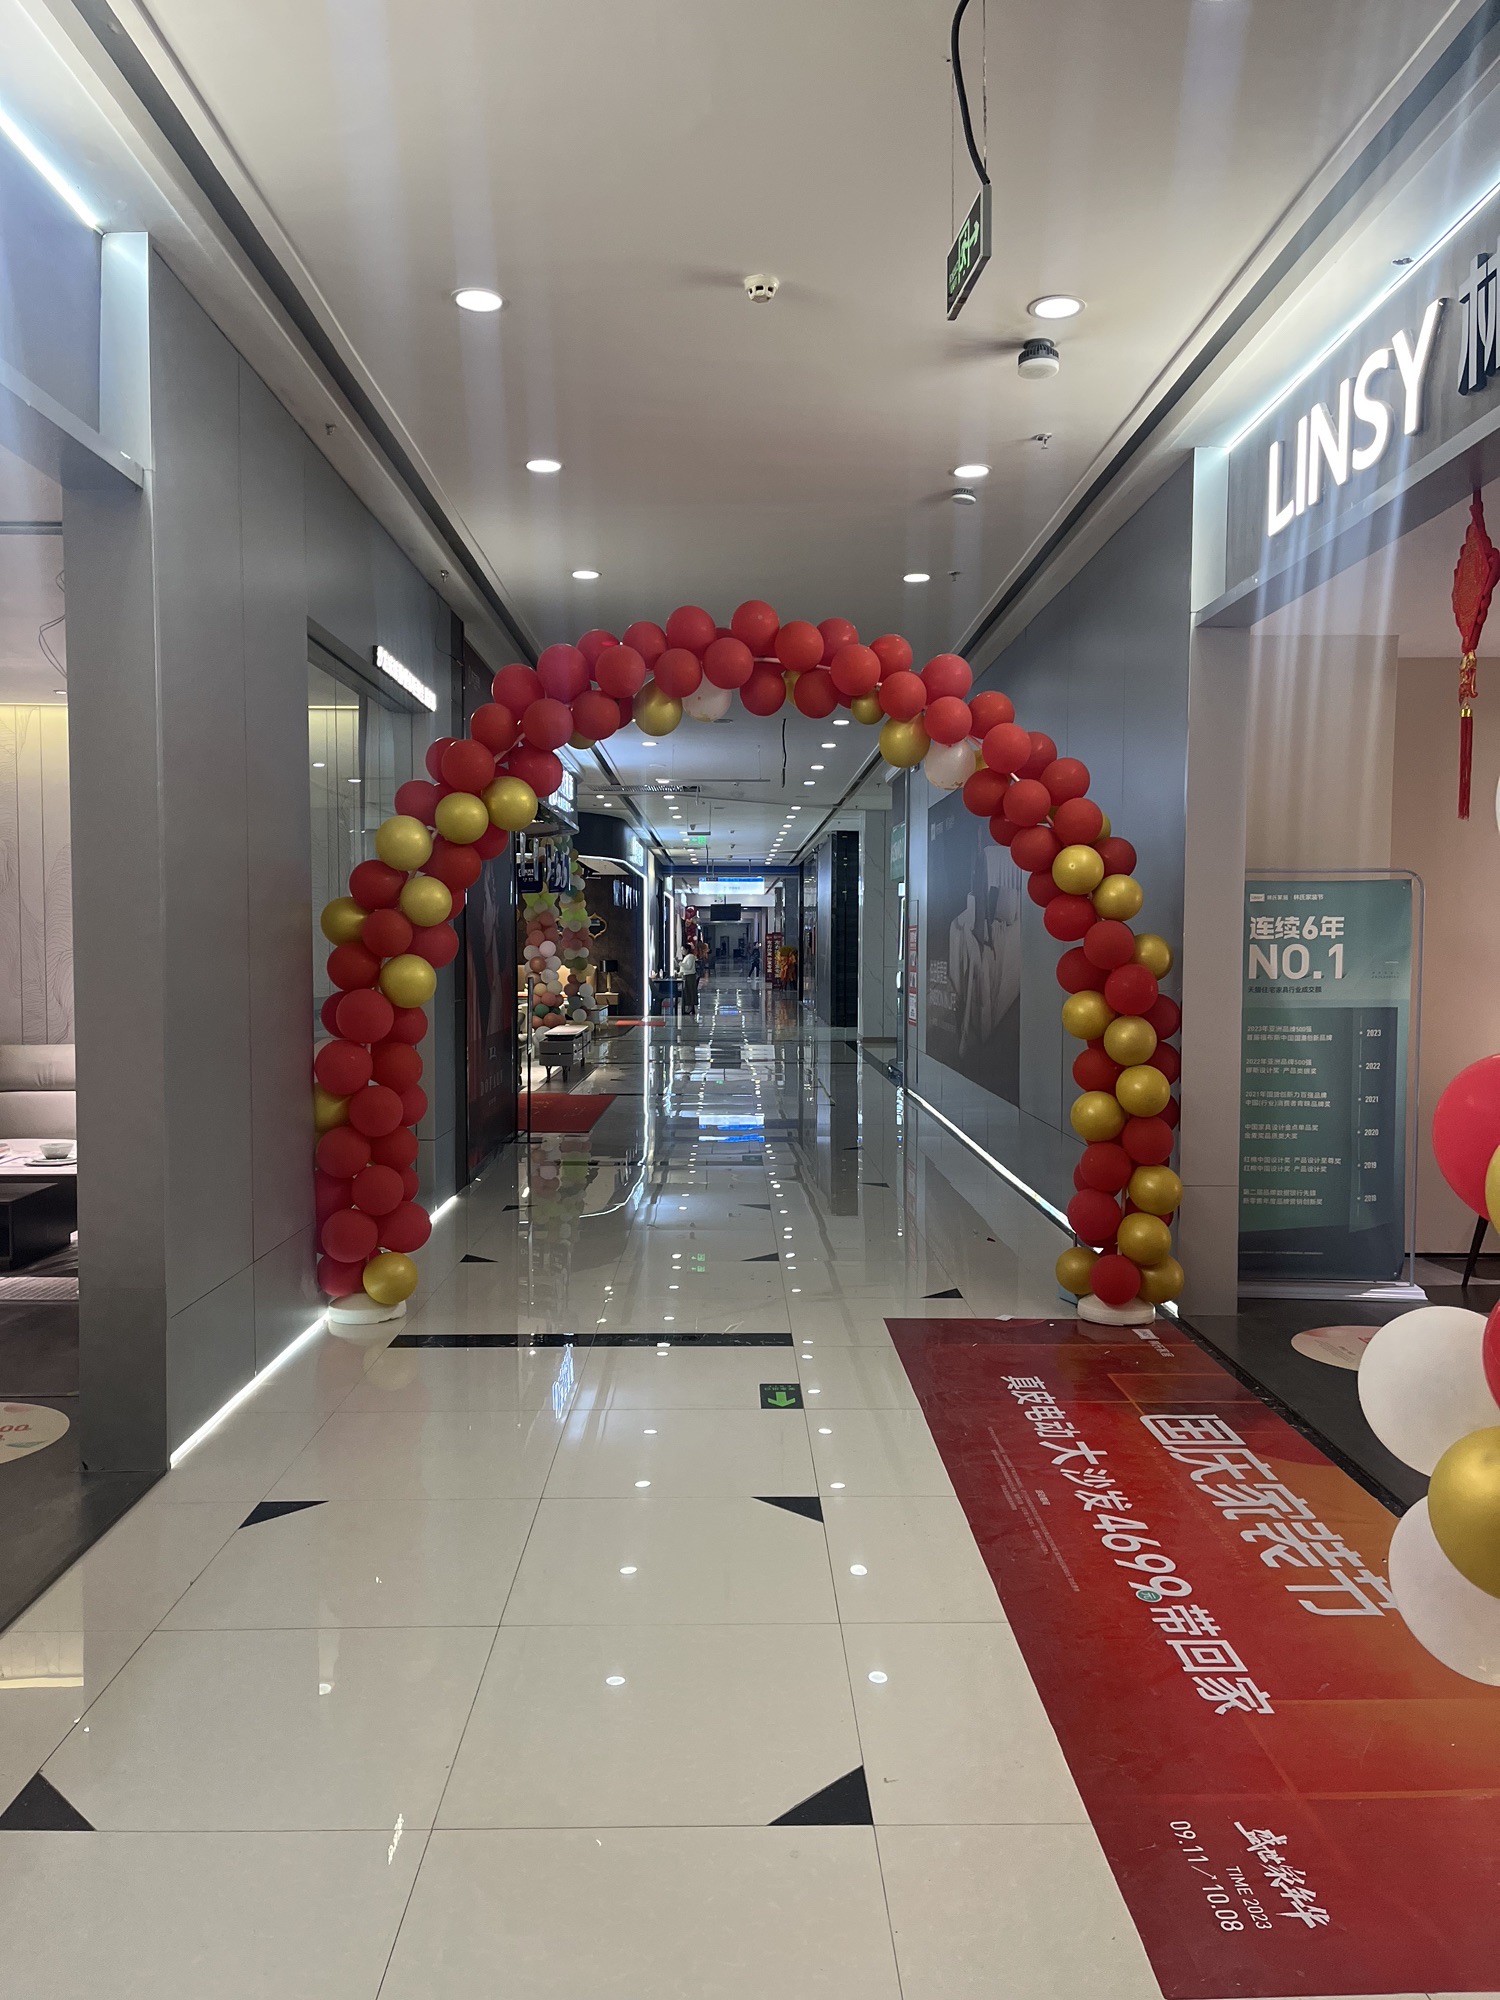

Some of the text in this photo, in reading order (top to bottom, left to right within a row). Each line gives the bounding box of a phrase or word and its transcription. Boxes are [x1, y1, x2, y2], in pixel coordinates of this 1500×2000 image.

[1268, 298, 1446, 537] LINSY
[1249, 916, 1345, 940] 连续6年
[1248, 943, 1344, 980] NO.1
[1366, 1029, 1382, 1037] 2023
[1365, 1062, 1380, 1070] 2022
[1364, 1128, 1379, 1136] 2020
[1363, 1161, 1377, 1169] 2019
[1139, 1413, 1398, 1617] 国庆家装节
[1226, 1865, 1272, 1930] TIME 2023
